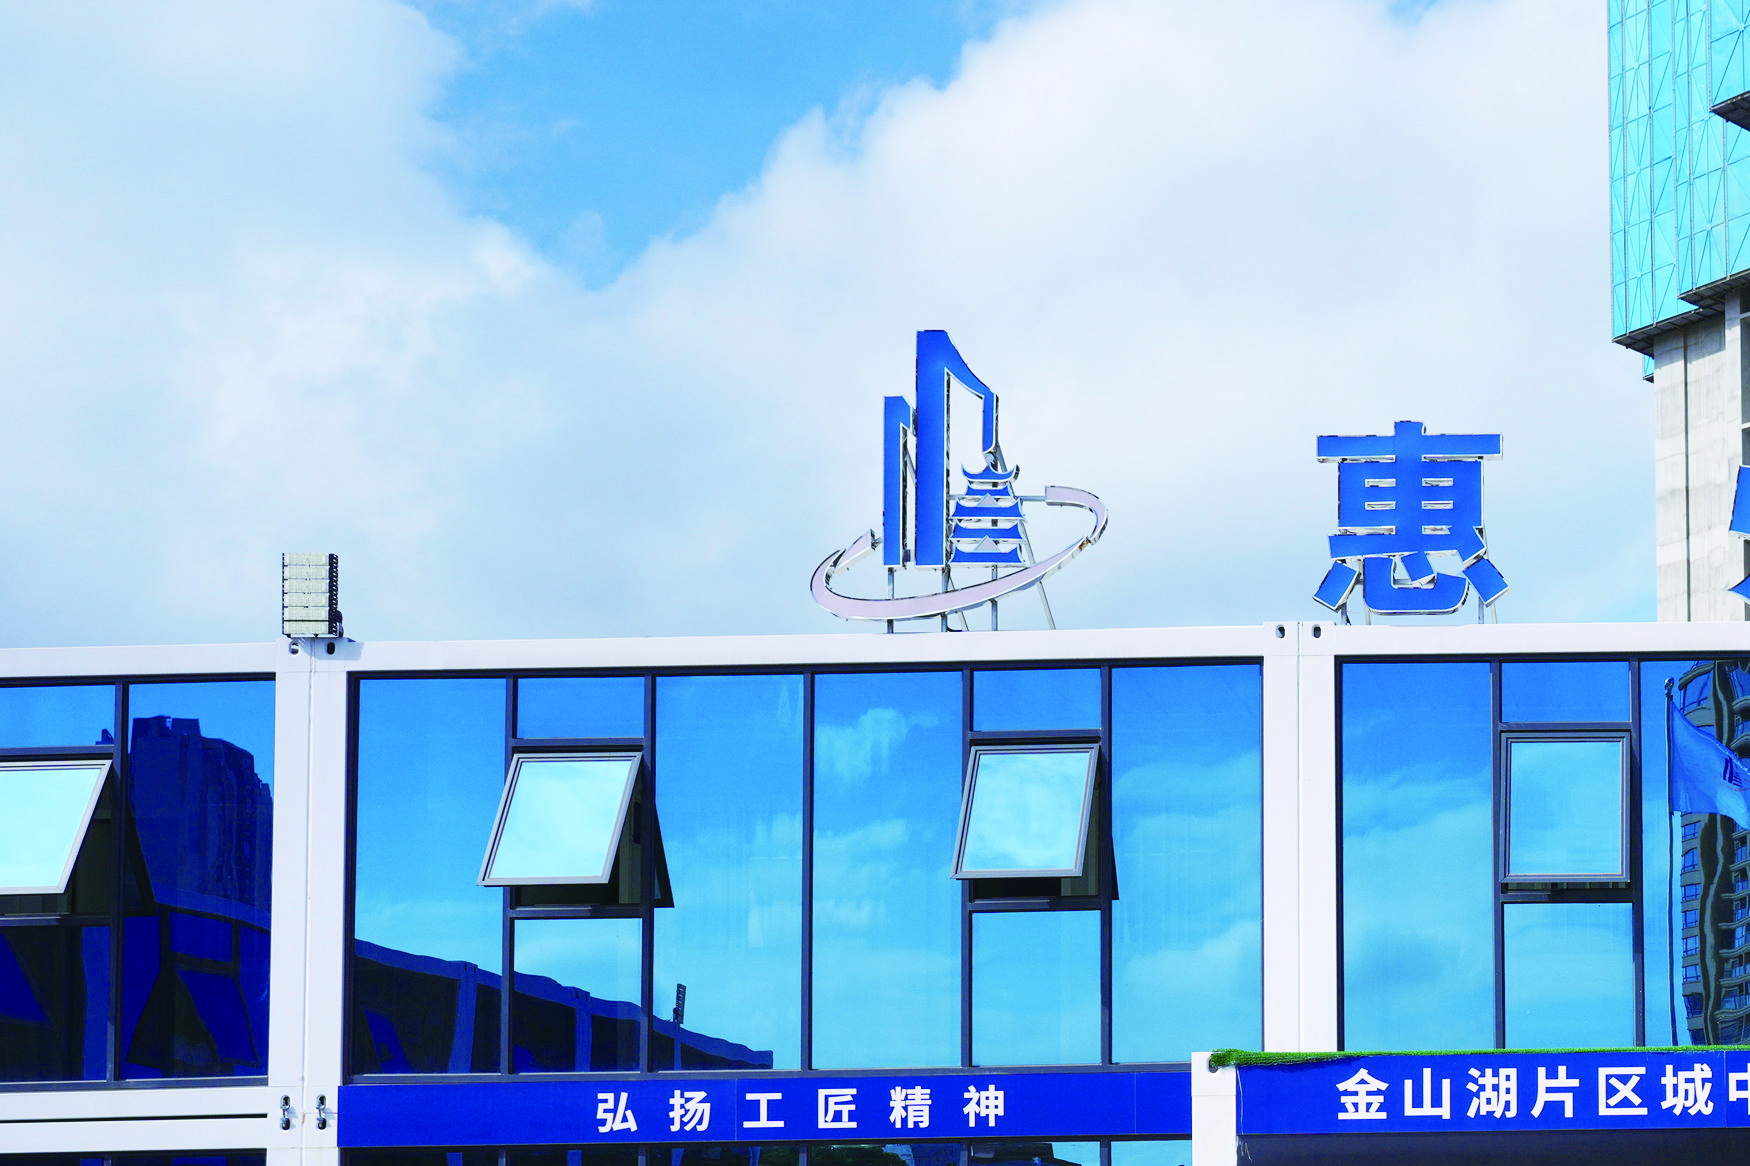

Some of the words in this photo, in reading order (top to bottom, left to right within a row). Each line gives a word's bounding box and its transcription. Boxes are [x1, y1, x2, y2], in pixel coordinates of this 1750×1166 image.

[596, 1084, 1004, 1133] 弘扬工匠精神
